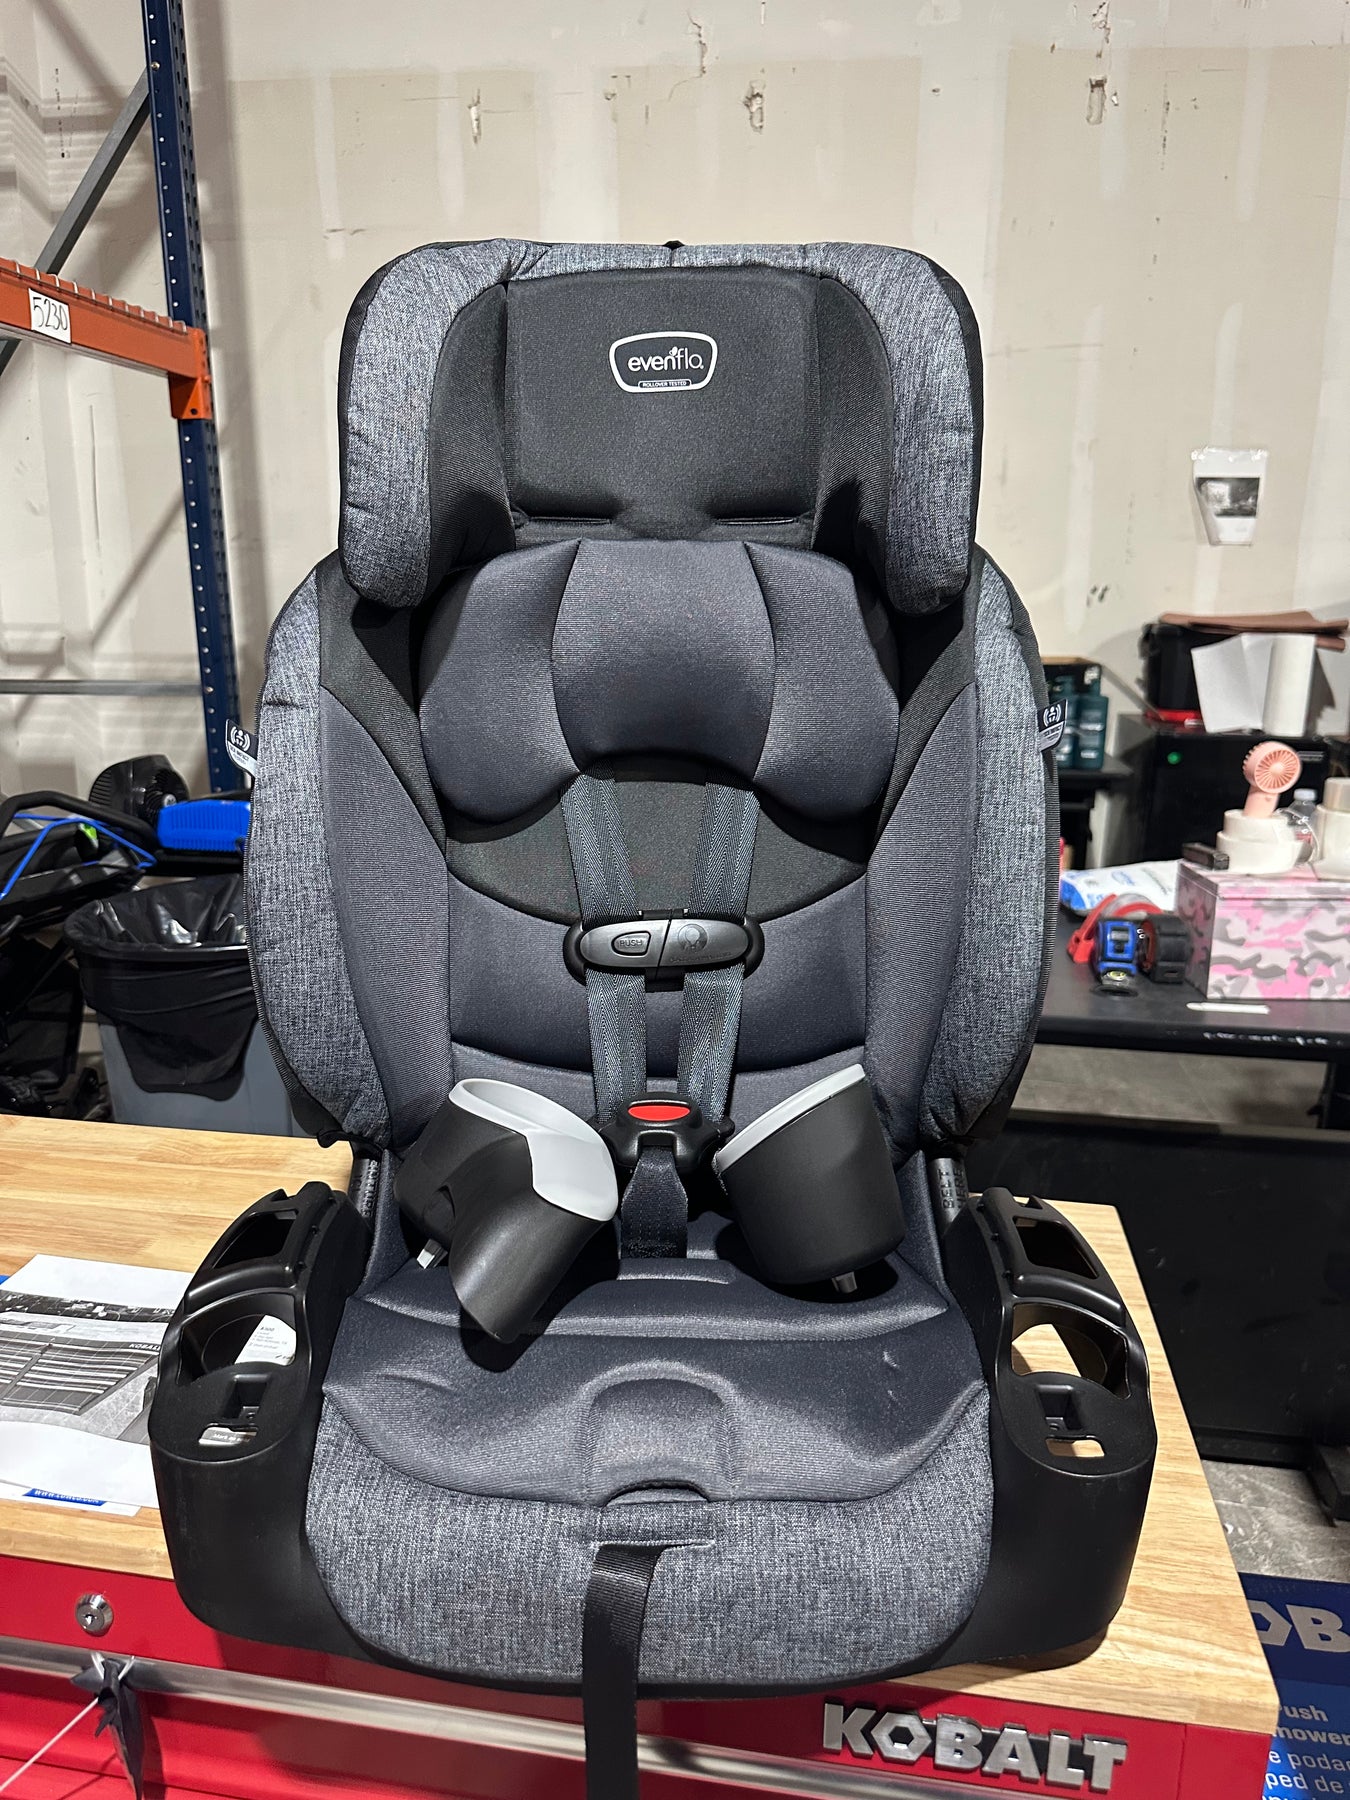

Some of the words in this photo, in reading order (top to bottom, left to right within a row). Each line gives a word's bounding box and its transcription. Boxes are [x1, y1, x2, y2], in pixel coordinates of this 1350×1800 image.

[33, 297, 68, 331] 5230
[627, 346, 704, 372] evenflo
[619, 939, 643, 947] PUSH
[1280, 1704, 1329, 1722] ush
[823, 1702, 1128, 1792] KOBALT
[1314, 1775, 1345, 1794] de
